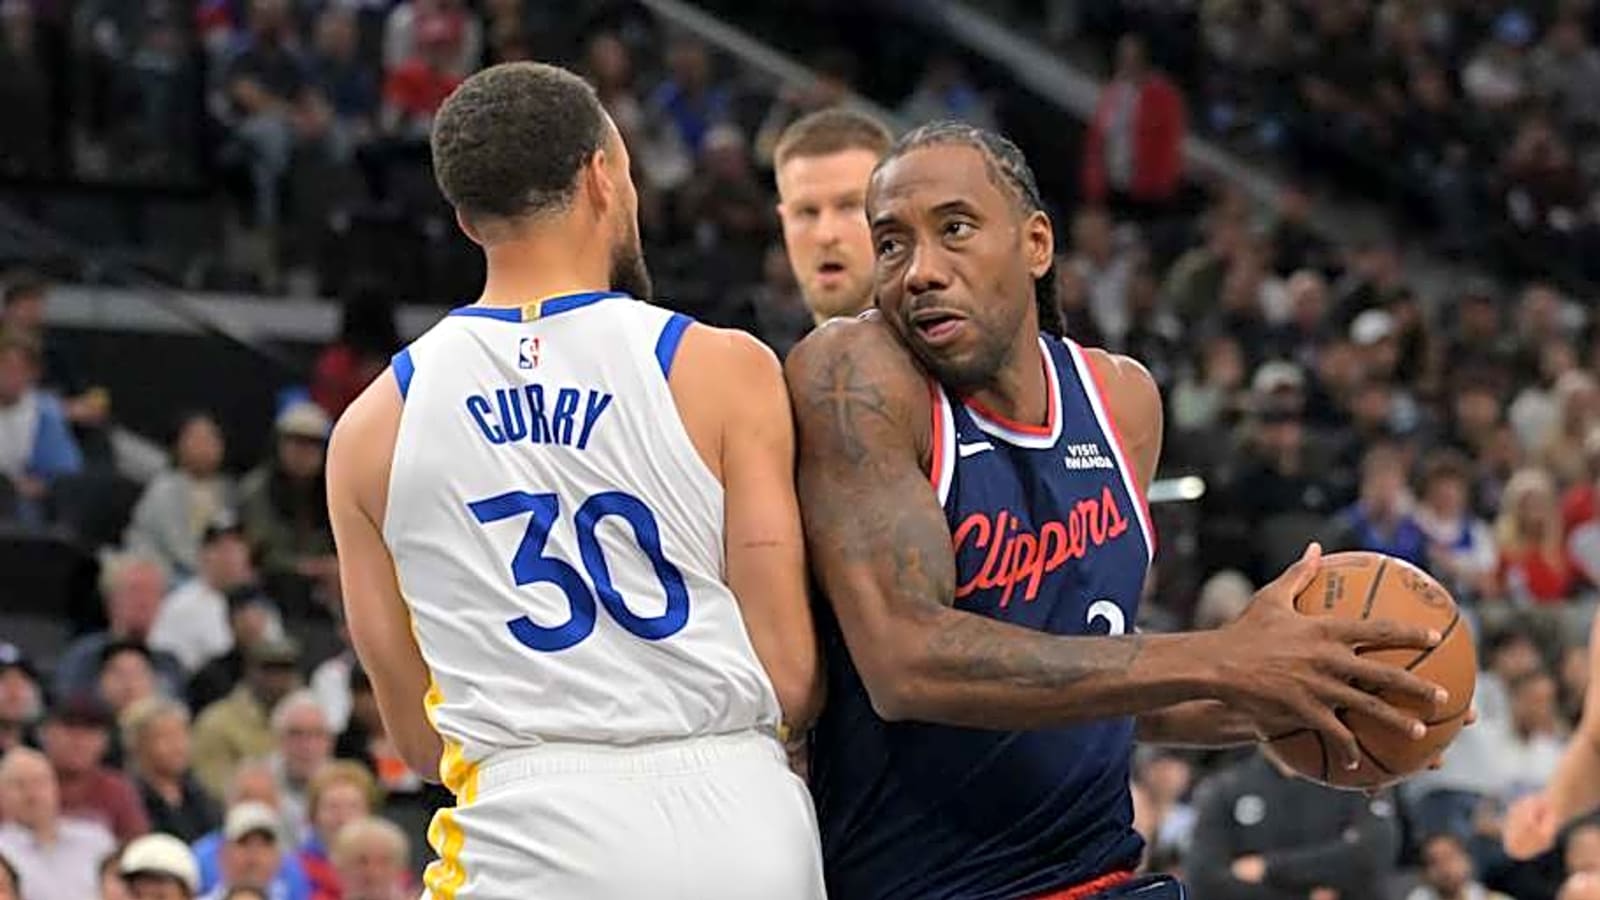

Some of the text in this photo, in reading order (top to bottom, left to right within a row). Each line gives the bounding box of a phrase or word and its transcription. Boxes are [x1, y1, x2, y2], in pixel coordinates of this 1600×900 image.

[466, 383, 612, 450] CURRY
[1067, 443, 1099, 456] VISIT
[467, 490, 690, 652] 30
[954, 486, 1128, 607] Clippers
